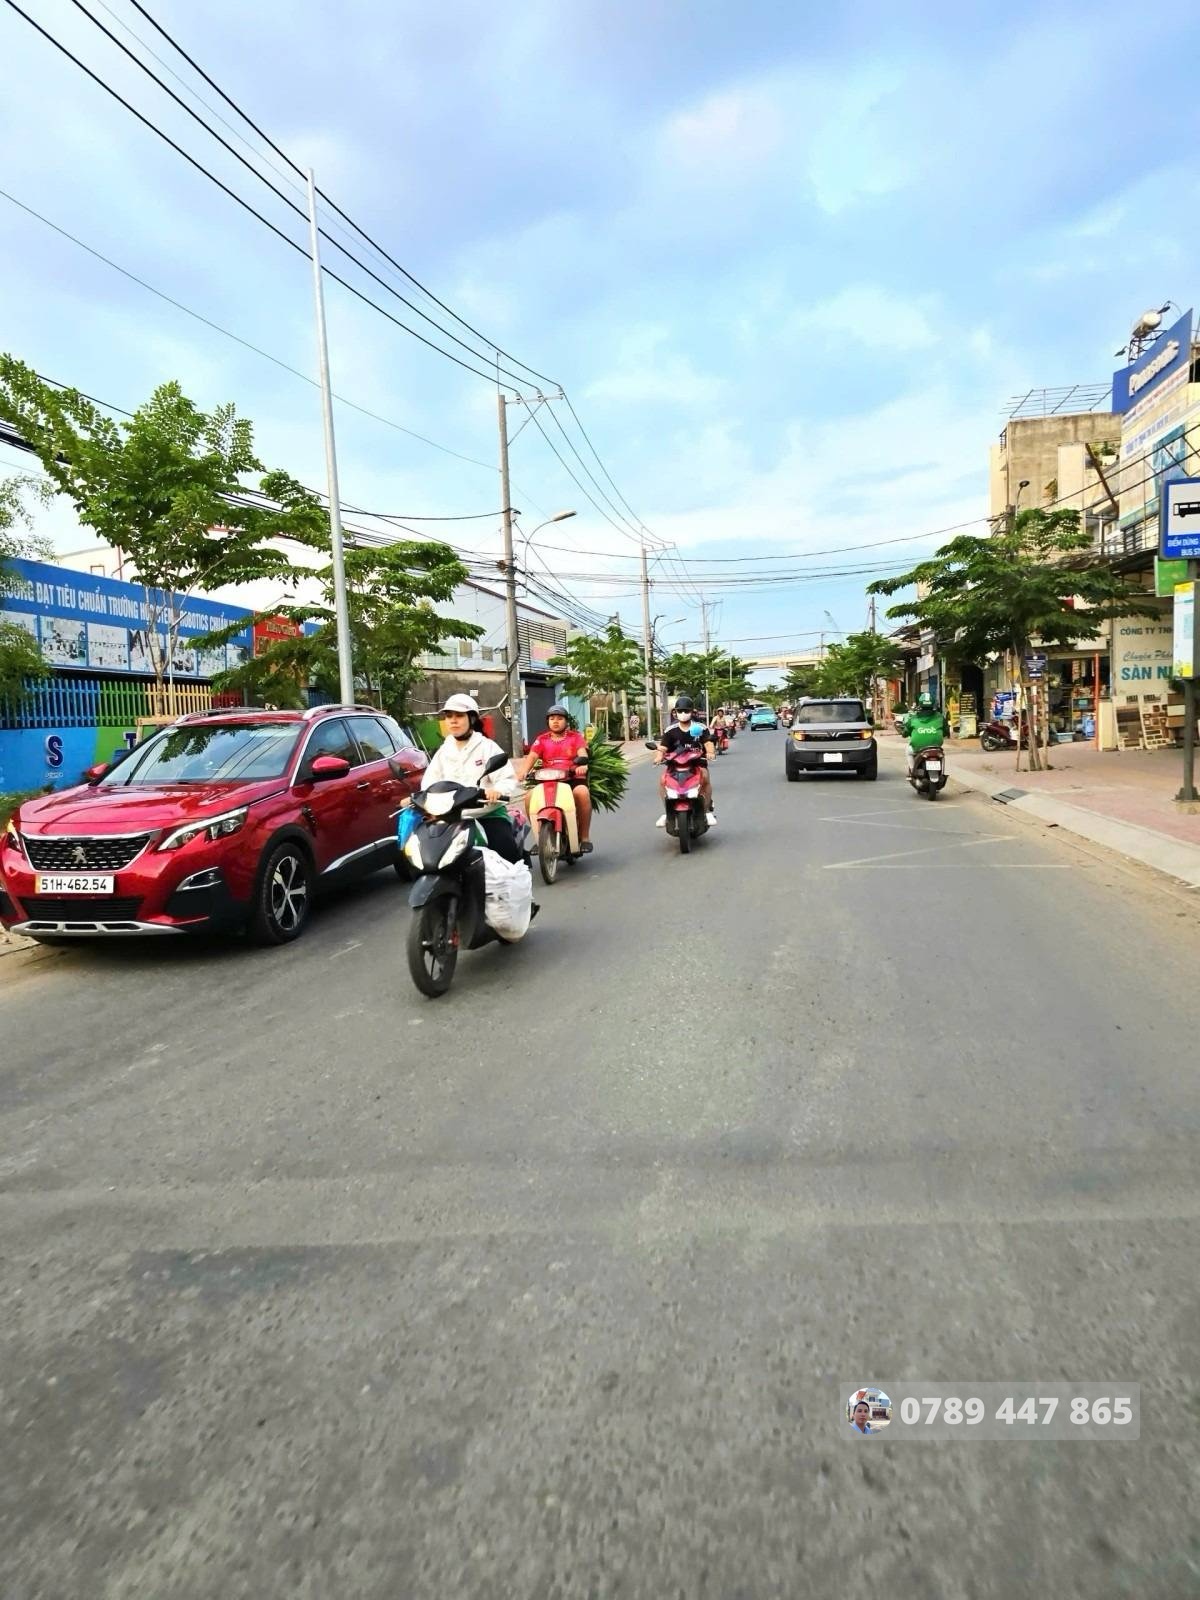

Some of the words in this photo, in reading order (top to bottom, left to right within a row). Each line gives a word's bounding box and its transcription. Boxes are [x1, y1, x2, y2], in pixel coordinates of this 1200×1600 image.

[56, 583, 76, 609] TIÊU
[78, 586, 107, 614] CHUẨN
[108, 595, 139, 619] TRƯỜNG
[1120, 626, 1143, 636] CÔNG
[1121, 664, 1152, 681] SÀN
[46, 734, 64, 767] S
[41, 878, 107, 891] 51H-462.54
